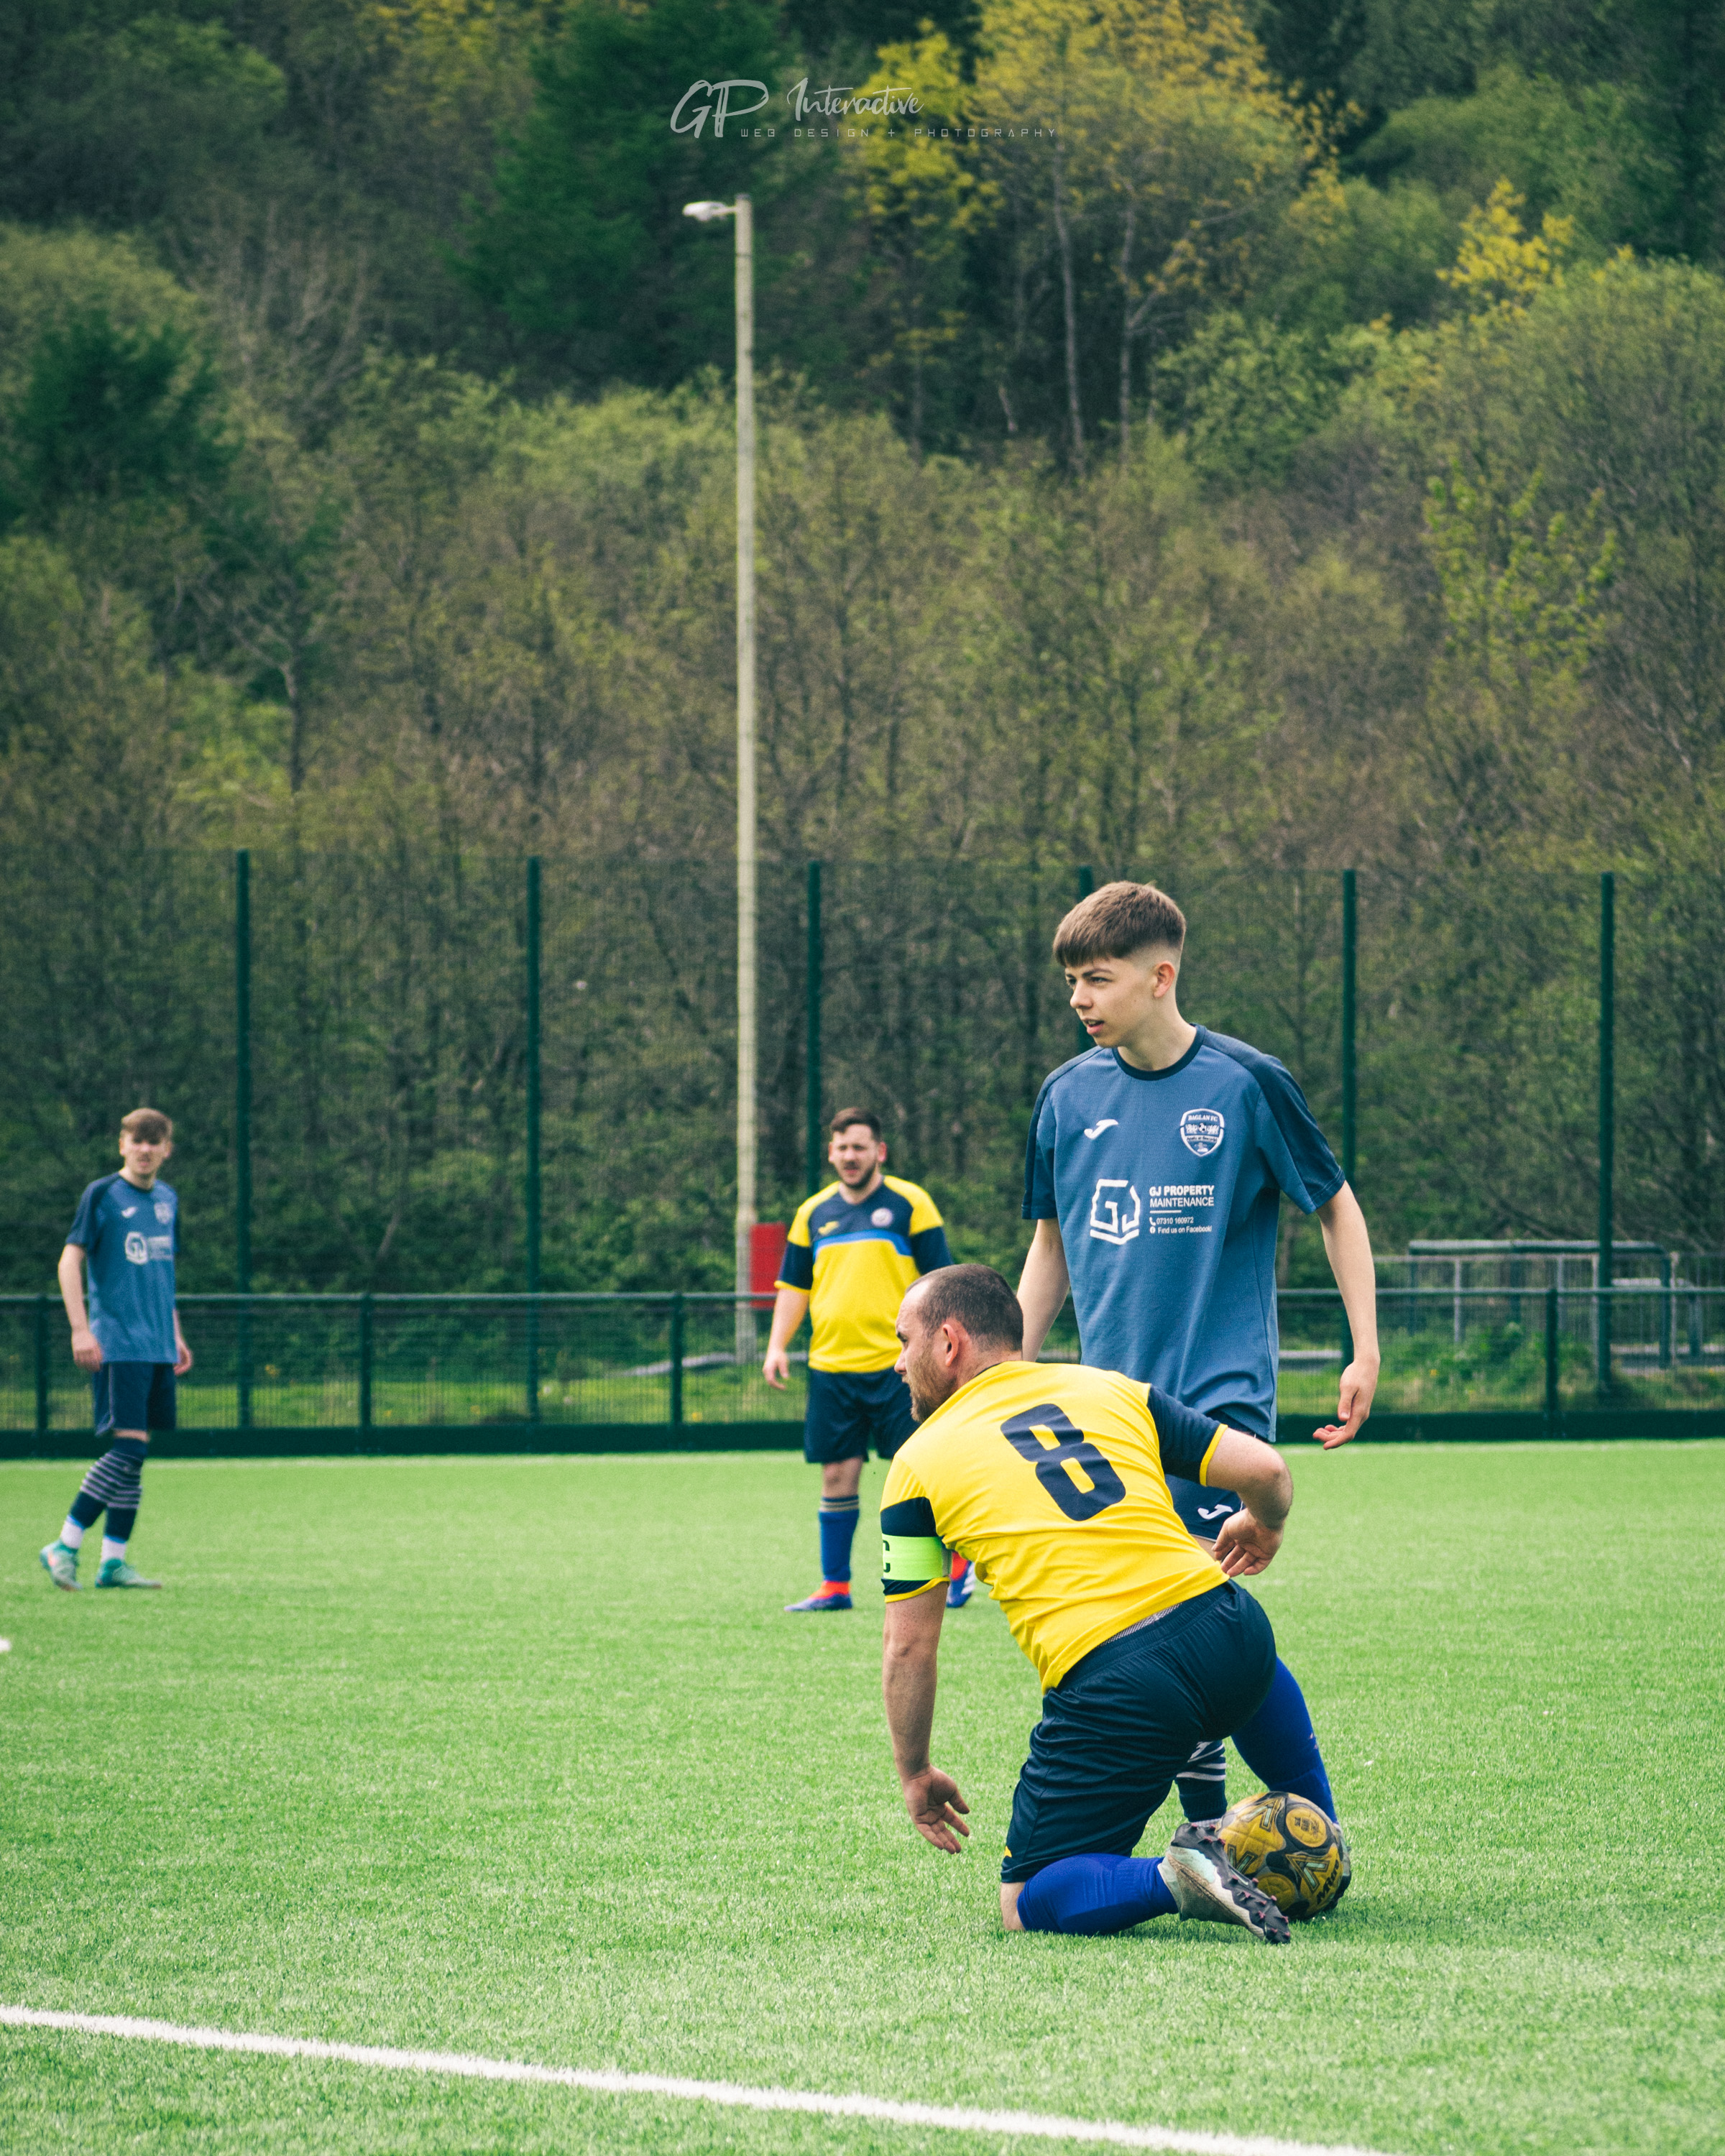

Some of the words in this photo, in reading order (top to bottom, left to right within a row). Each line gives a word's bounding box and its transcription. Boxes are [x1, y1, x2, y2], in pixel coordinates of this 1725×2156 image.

[1149, 1186, 1162, 1197] GJ
[1164, 1184, 1215, 1196] PROPERTY
[1149, 1197, 1215, 1207] MAINTENANCE
[1000, 1403, 1126, 1522] 8
